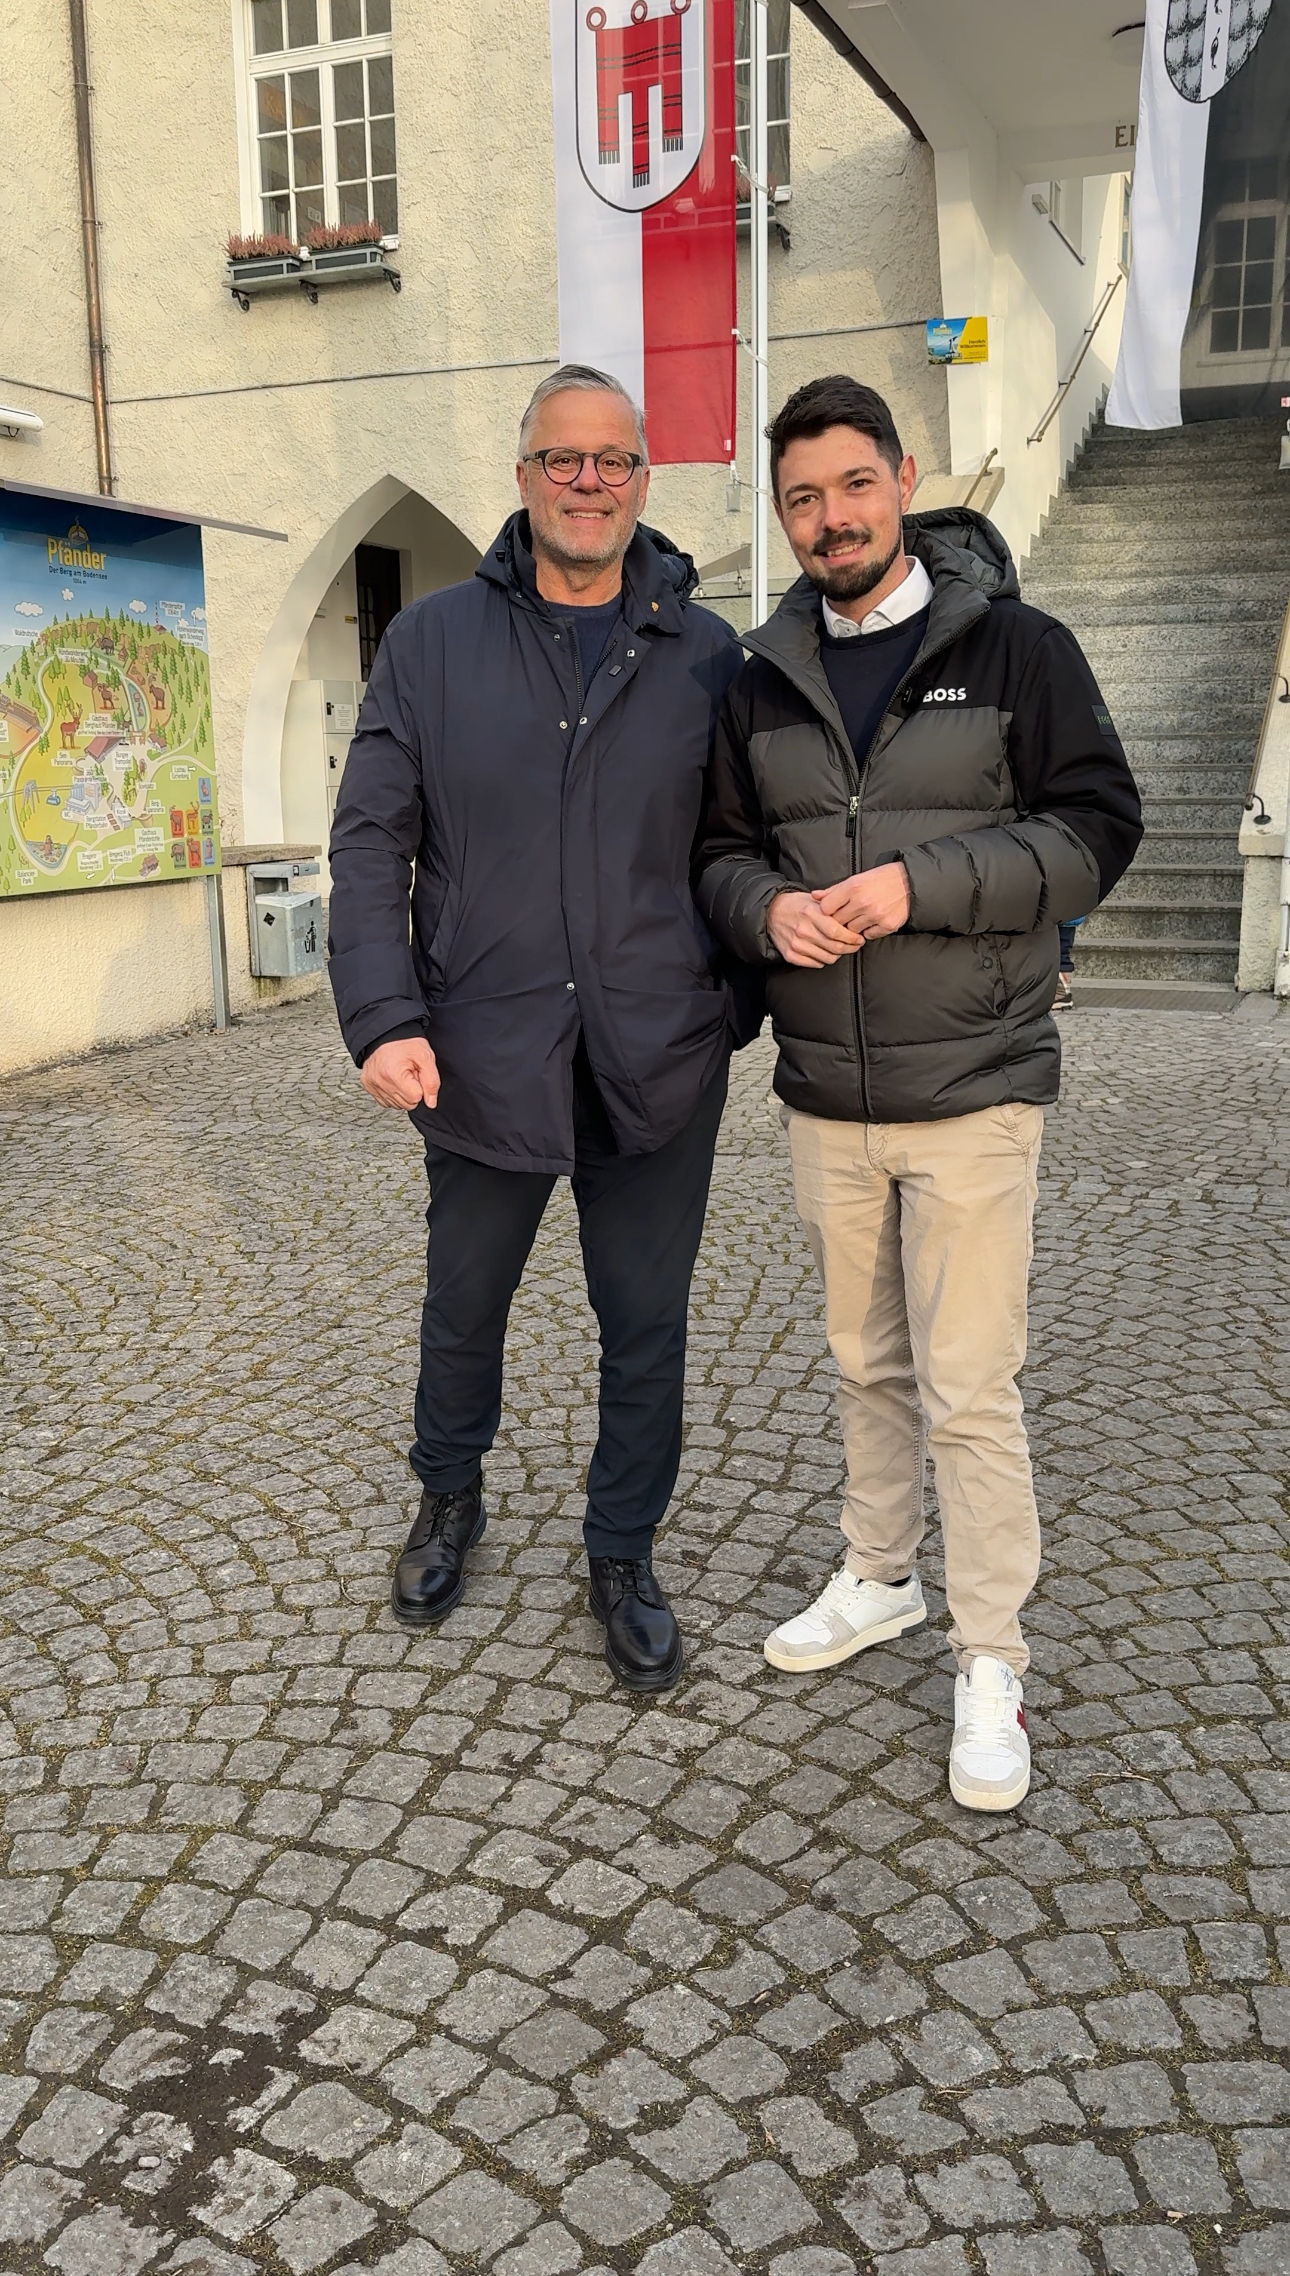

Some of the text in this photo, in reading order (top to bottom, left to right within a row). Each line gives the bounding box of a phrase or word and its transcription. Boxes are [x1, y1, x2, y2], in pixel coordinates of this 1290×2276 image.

[1115, 124, 1136, 148] EI
[47, 537, 107, 571] Pfänder
[48, 565, 59, 574] Der
[59, 566, 73, 578] Berg
[82, 570, 108, 580] Bodensee
[922, 687, 967, 703] BOSS
[85, 815, 107, 823] Bergstation
[85, 822, 108, 830] Pfänderbahn
[22, 877, 32, 885] Park
